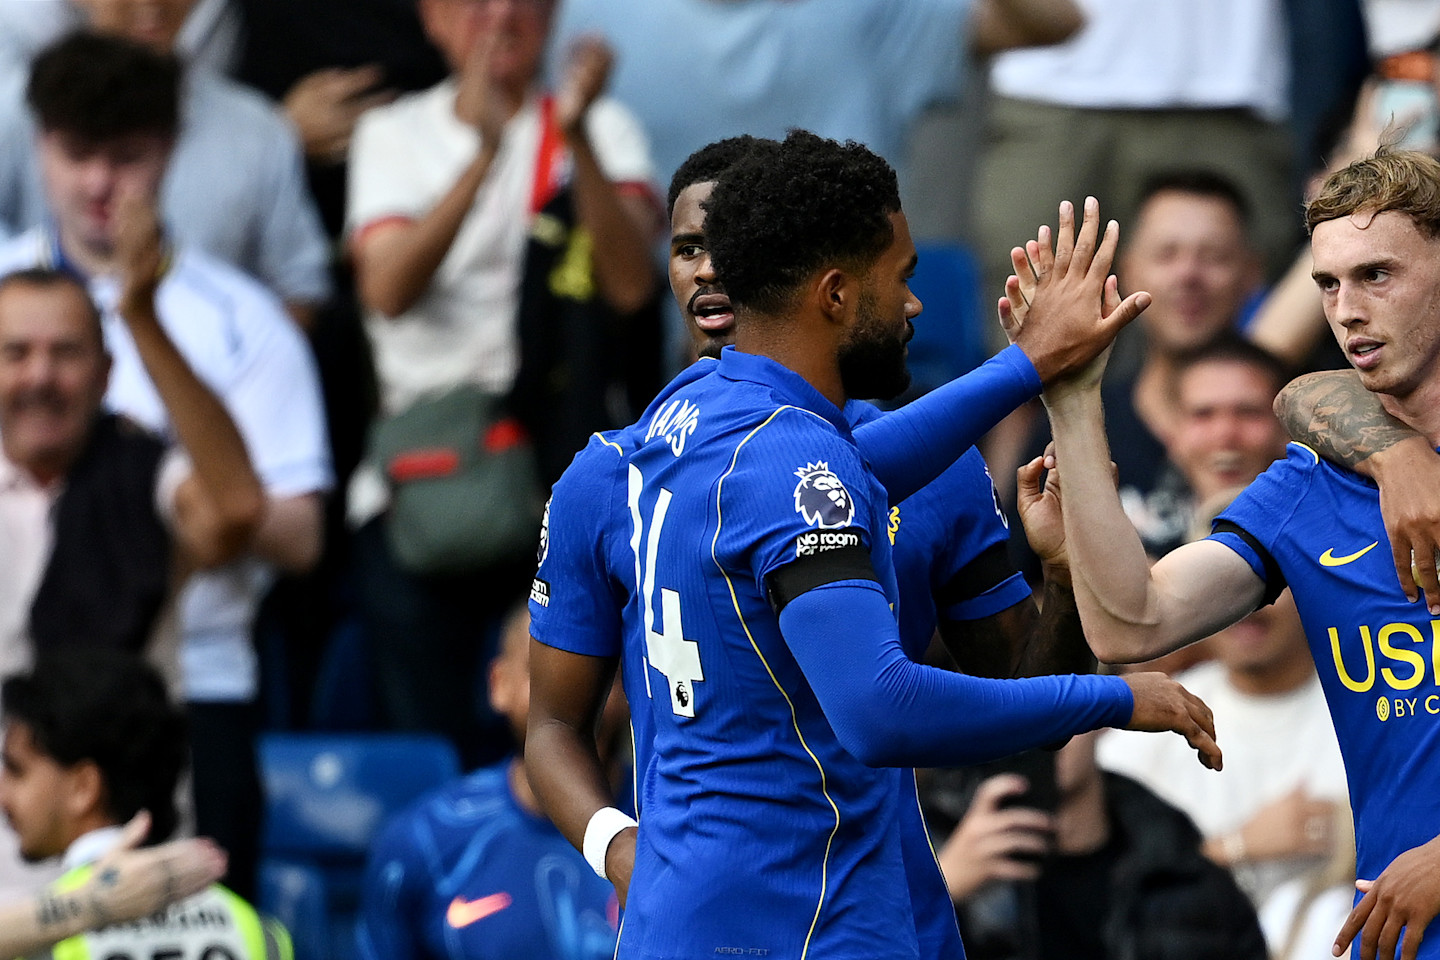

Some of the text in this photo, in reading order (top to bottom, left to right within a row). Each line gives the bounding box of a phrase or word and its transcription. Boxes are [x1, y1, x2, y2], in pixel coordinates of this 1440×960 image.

[820, 533, 858, 547] room
[1394, 697, 1418, 718] BY
[714, 946, 769, 956] AERO-FIT
